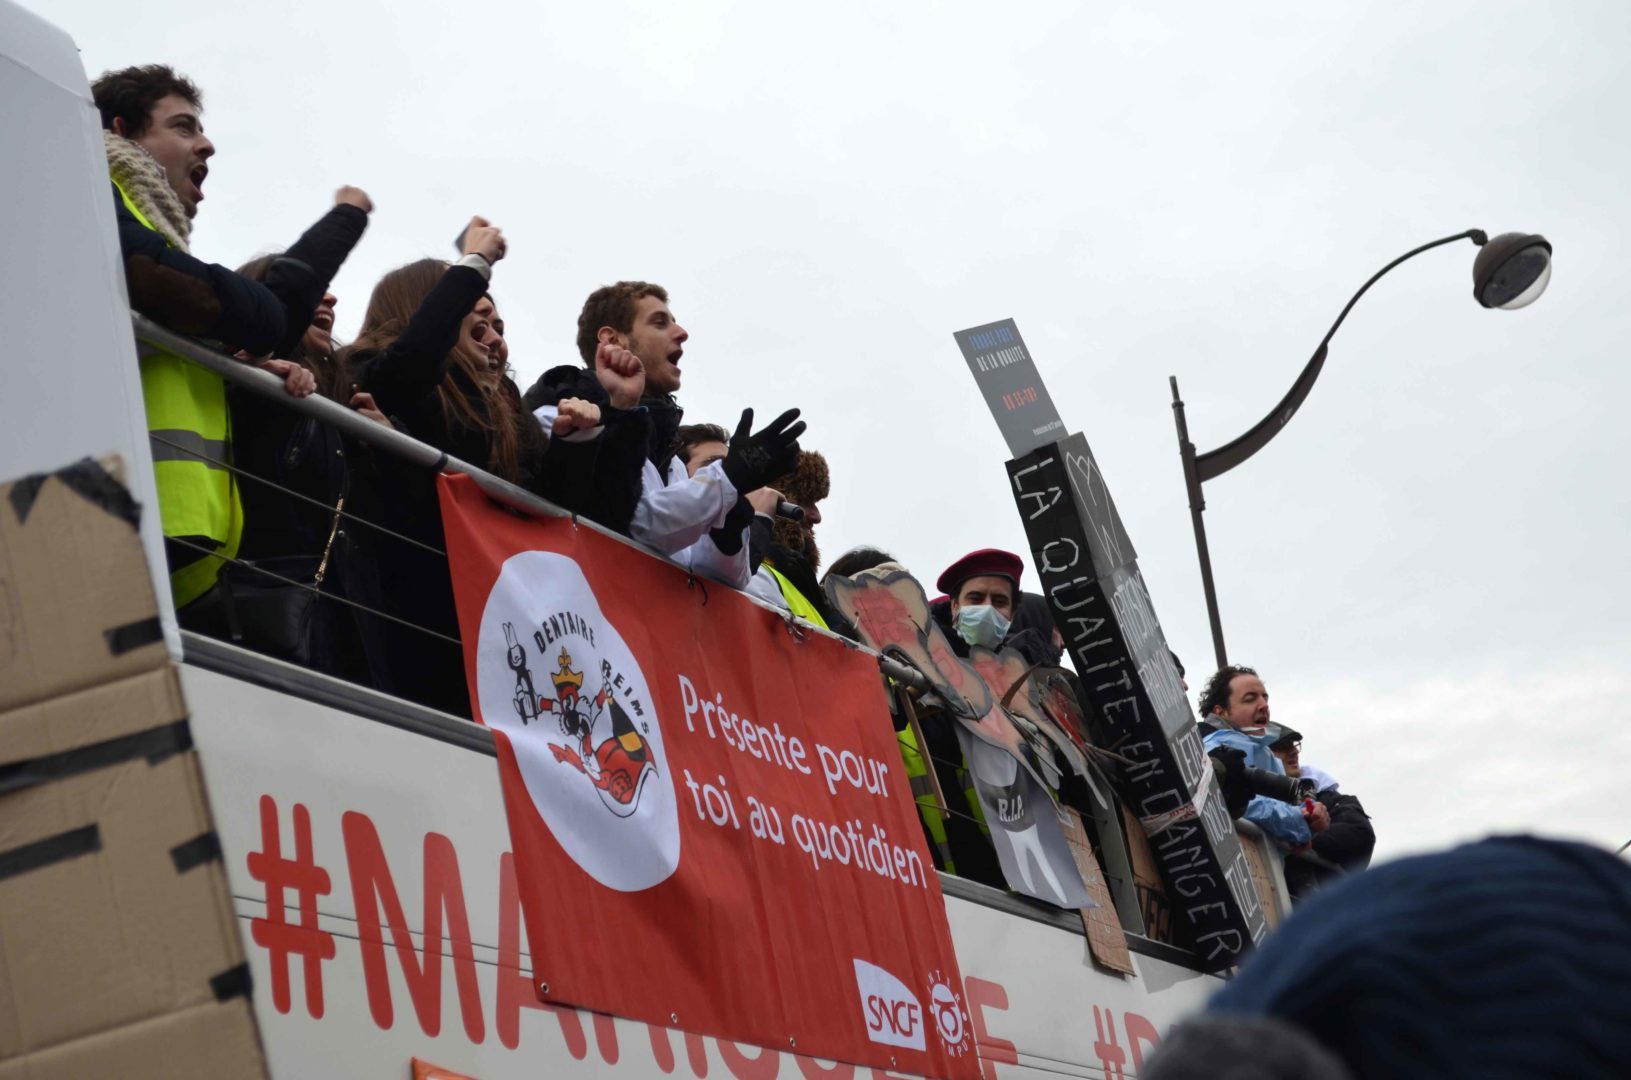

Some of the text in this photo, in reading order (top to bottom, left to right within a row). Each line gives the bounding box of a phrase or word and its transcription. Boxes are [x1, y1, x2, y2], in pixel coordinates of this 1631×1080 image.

[1013, 456, 1063, 521] LA
[532, 610, 650, 735] DENTAIRE REIMS
[677, 673, 888, 798] Présente pour
[683, 768, 928, 889] toi au quotidien
[867, 994, 919, 1038] SNCF
